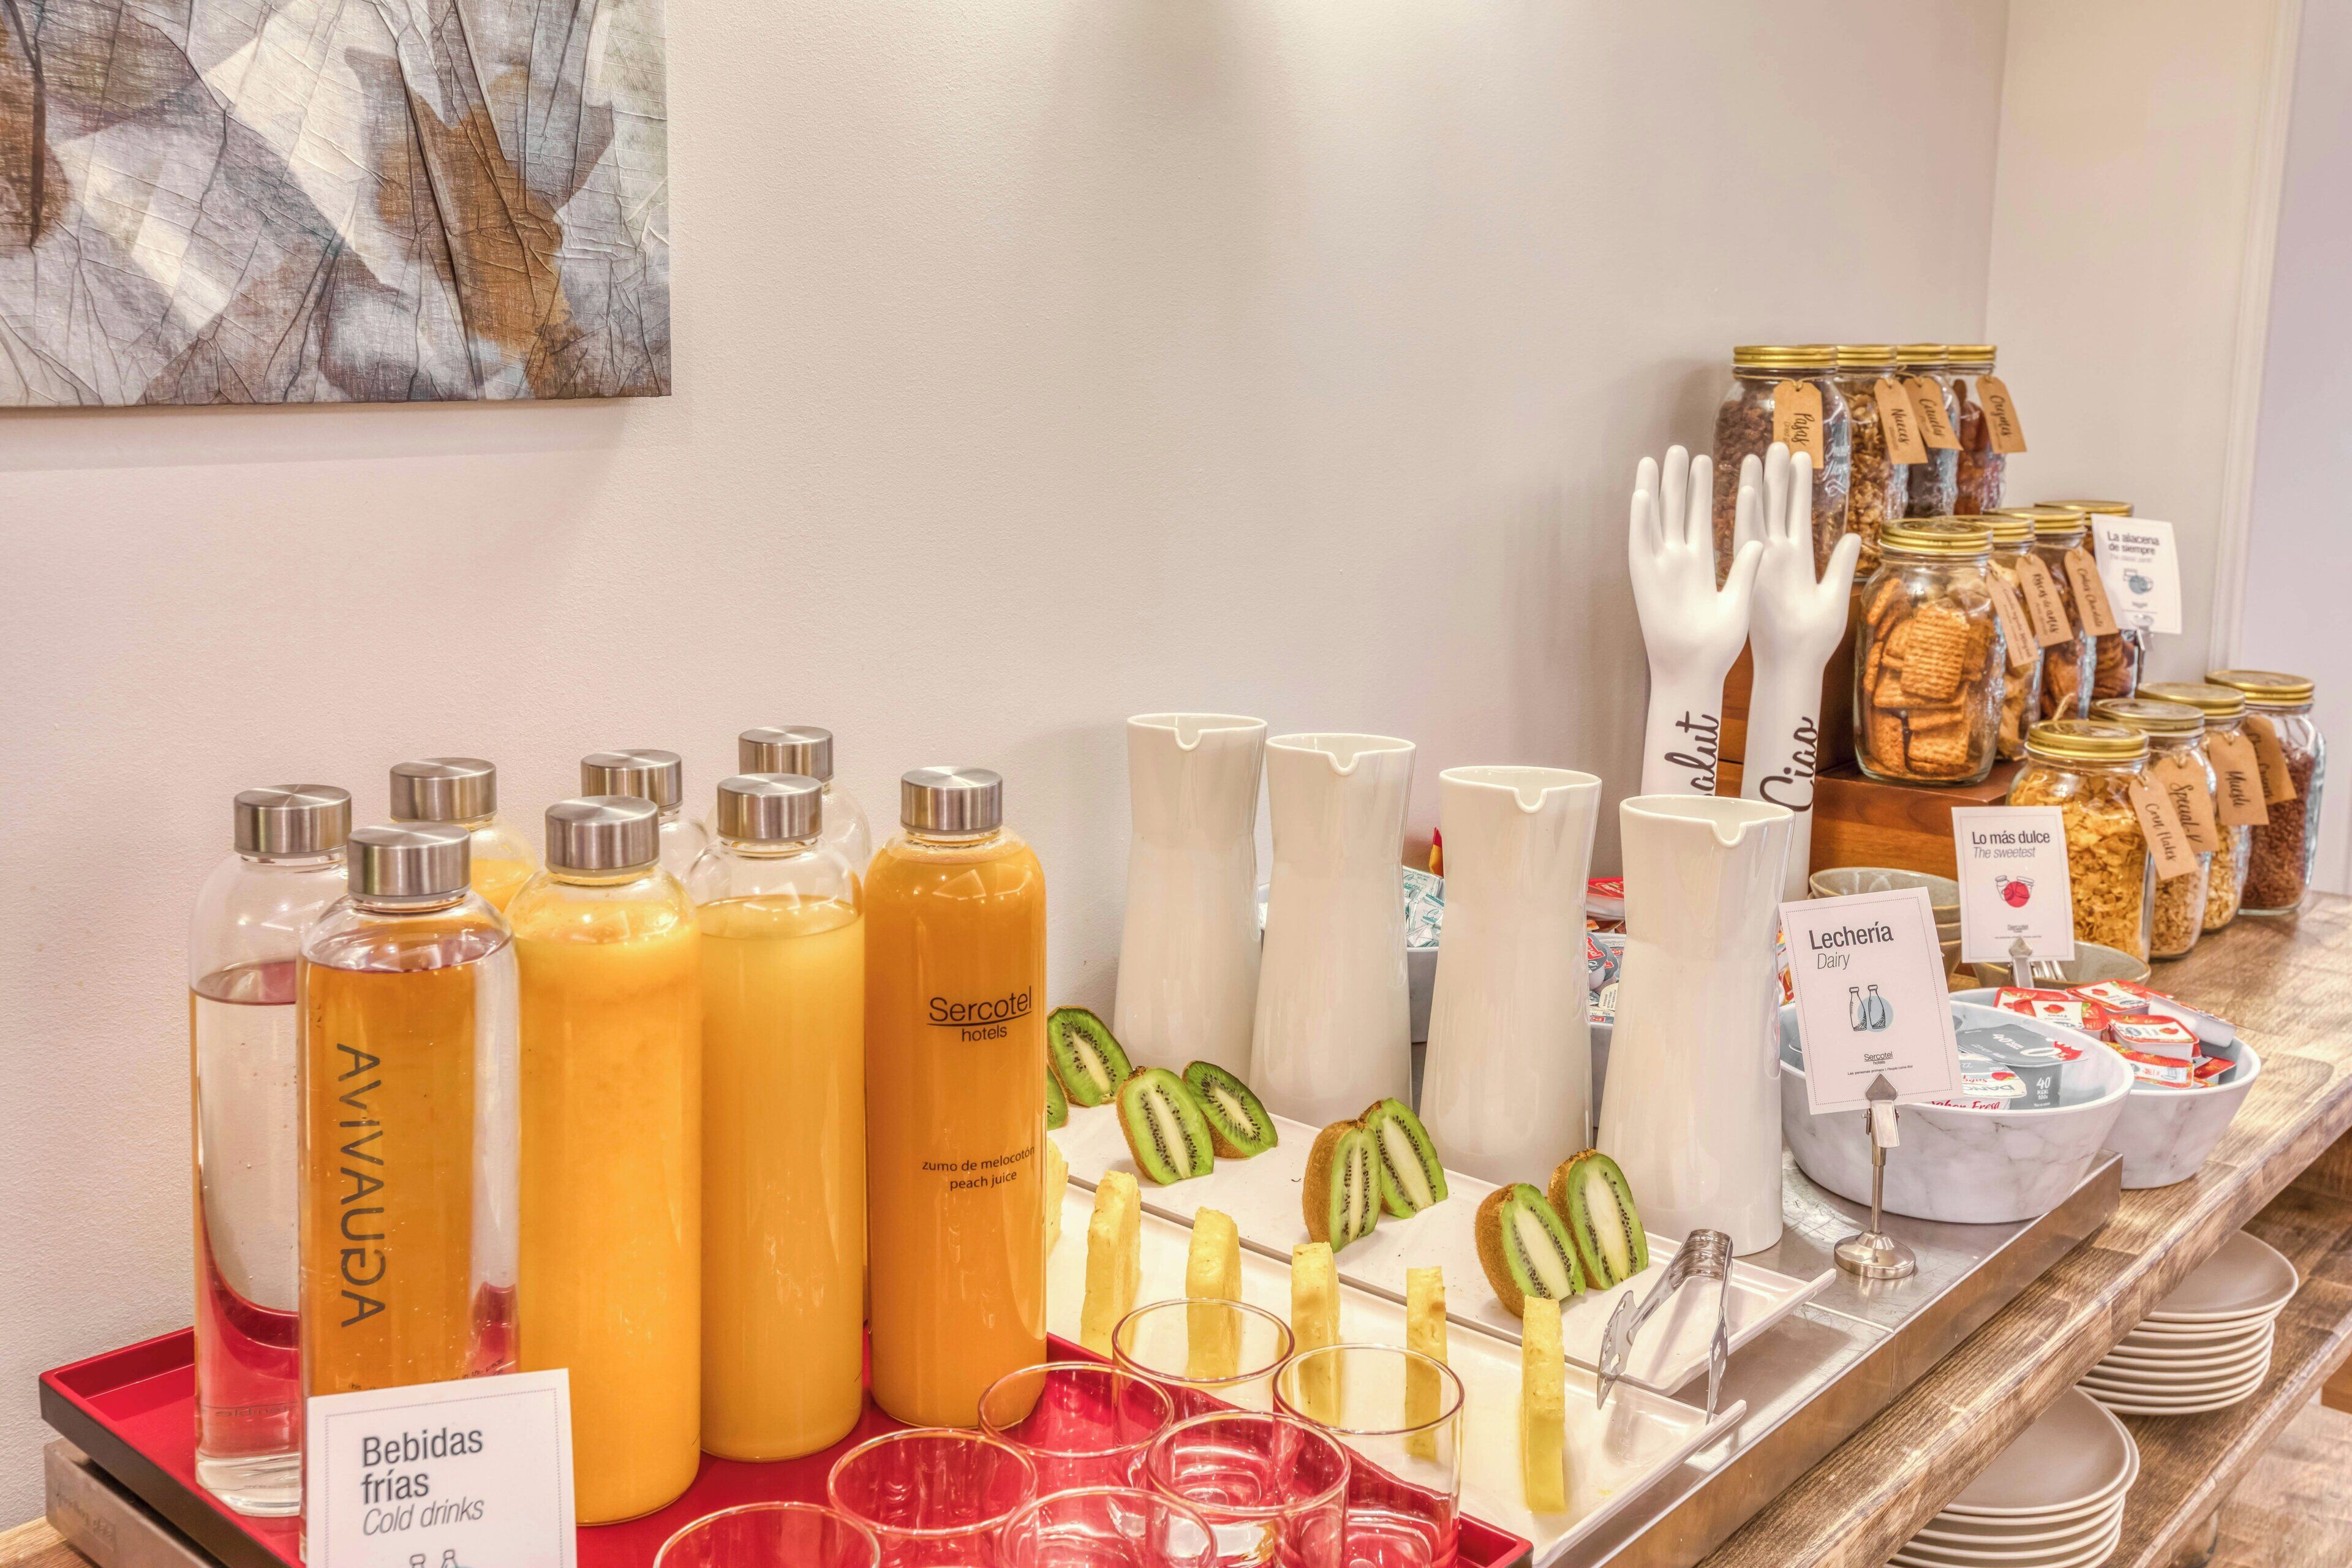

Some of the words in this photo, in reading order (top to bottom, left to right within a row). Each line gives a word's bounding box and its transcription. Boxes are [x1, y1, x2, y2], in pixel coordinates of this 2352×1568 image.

[1791, 413, 1815, 446] Pasas
[1891, 409, 1910, 445] Nueces
[2122, 544, 2155, 556] siempre
[1664, 710, 1719, 797] alut
[1760, 716, 1817, 812] Ciao
[2225, 771, 2251, 808] Muesli
[1972, 831, 1987, 845] Lo
[1990, 830, 2015, 845] más
[2019, 830, 2050, 843] dulce
[2145, 802, 2165, 832] Corn
[2155, 831, 2176, 862] Flakes
[1973, 846, 1991, 859] The
[1994, 846, 2035, 858] sweetest
[1809, 921, 1894, 950] Lechería
[1817, 953, 1850, 970] Dairy
[929, 986, 1032, 1022] Sercotel
[962, 1024, 1008, 1042] hotels
[1864, 1051, 1893, 1061] Sercotel
[2037, 1077, 2051, 1090] 40
[922, 1161, 957, 1172] zumo
[961, 1160, 977, 1171] de
[981, 1145, 1035, 1169] melocotón
[950, 1175, 988, 1191] peach
[990, 1170, 1017, 1188] juice
[361, 1427, 483, 1468] Bebidas
[360, 1469, 430, 1505] frías
[363, 1503, 415, 1536] Cold
[420, 1496, 484, 1528] drinks
